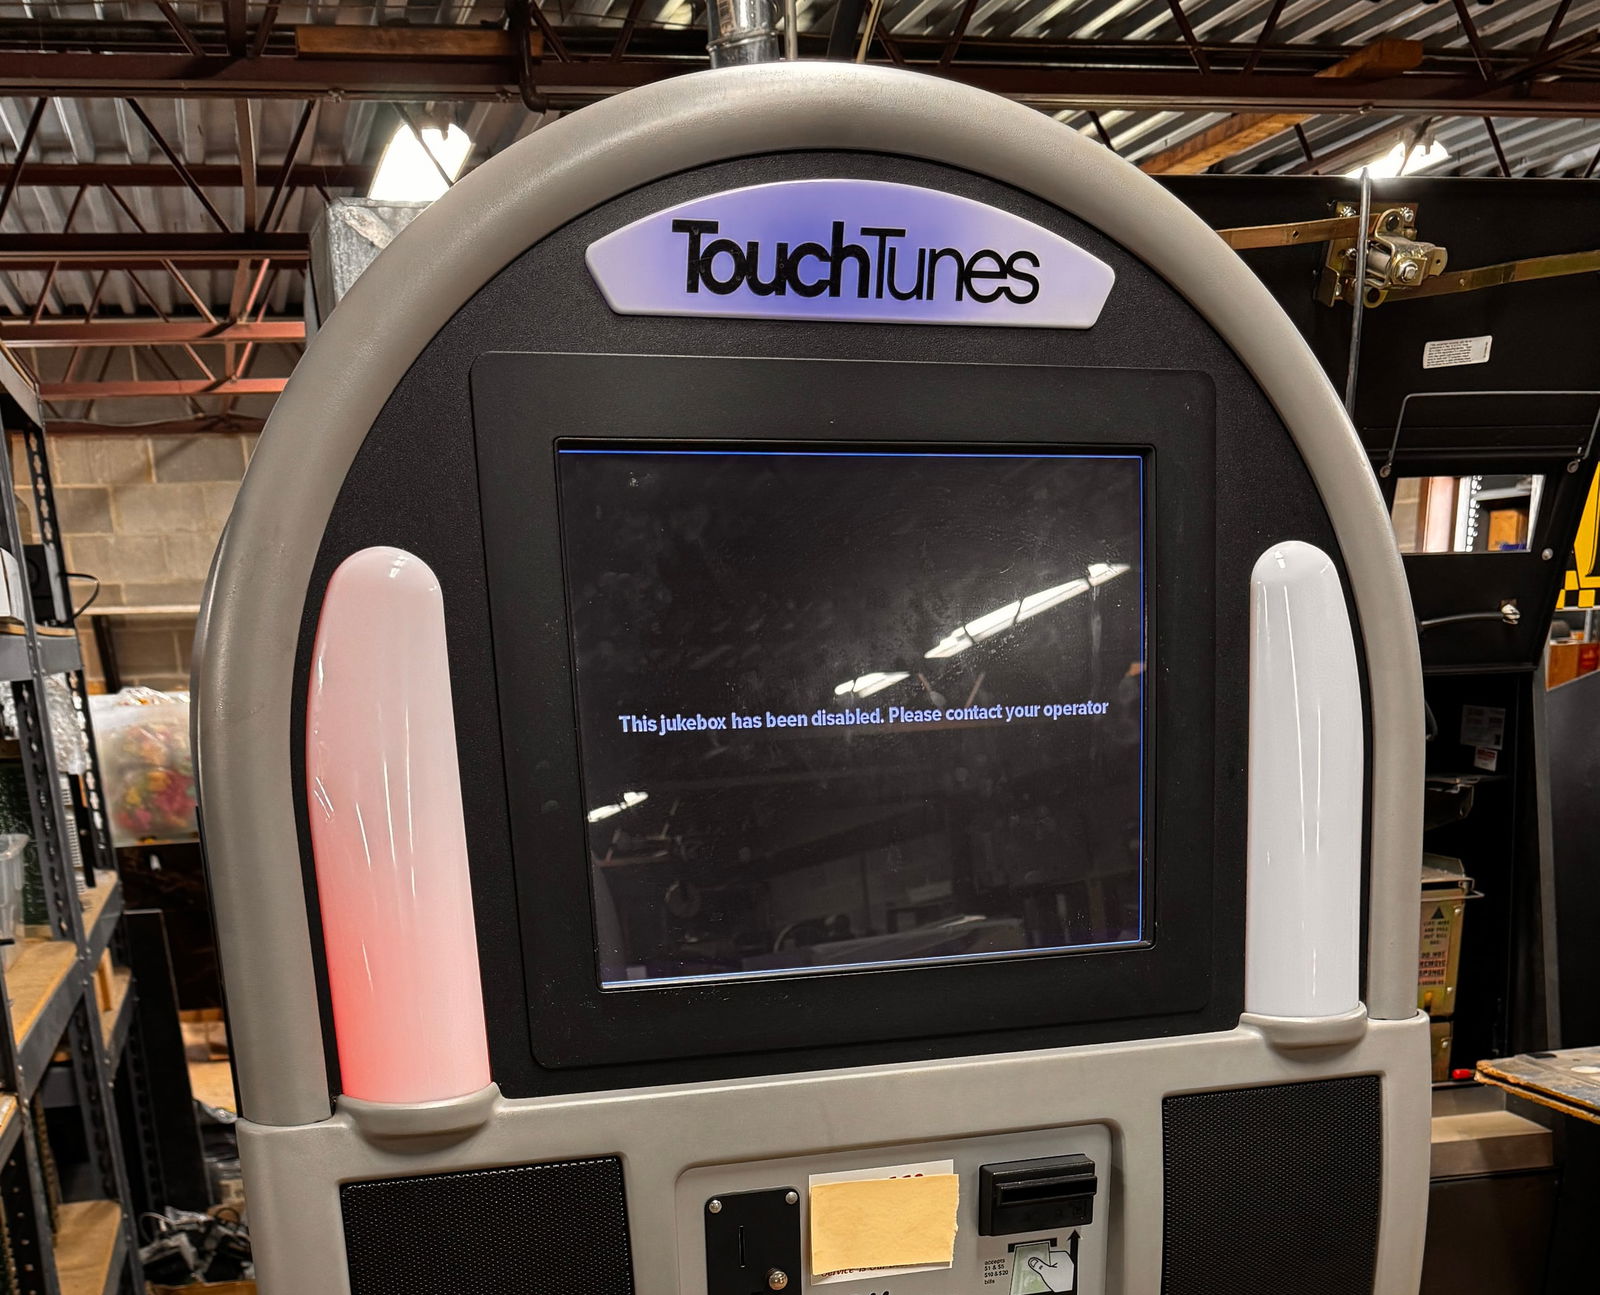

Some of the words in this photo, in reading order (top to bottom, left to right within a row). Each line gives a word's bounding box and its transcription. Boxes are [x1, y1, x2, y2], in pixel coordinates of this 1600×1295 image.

[672, 219, 1040, 304] TouchTunes
[618, 714, 657, 733] This
[659, 713, 727, 736] jukebox
[731, 712, 762, 729] has
[766, 711, 808, 728] been
[811, 708, 884, 726] disabled.
[889, 706, 942, 723] Please
[945, 704, 1002, 721] contact
[1005, 704, 1041, 723] your
[1043, 700, 1109, 720] operator
